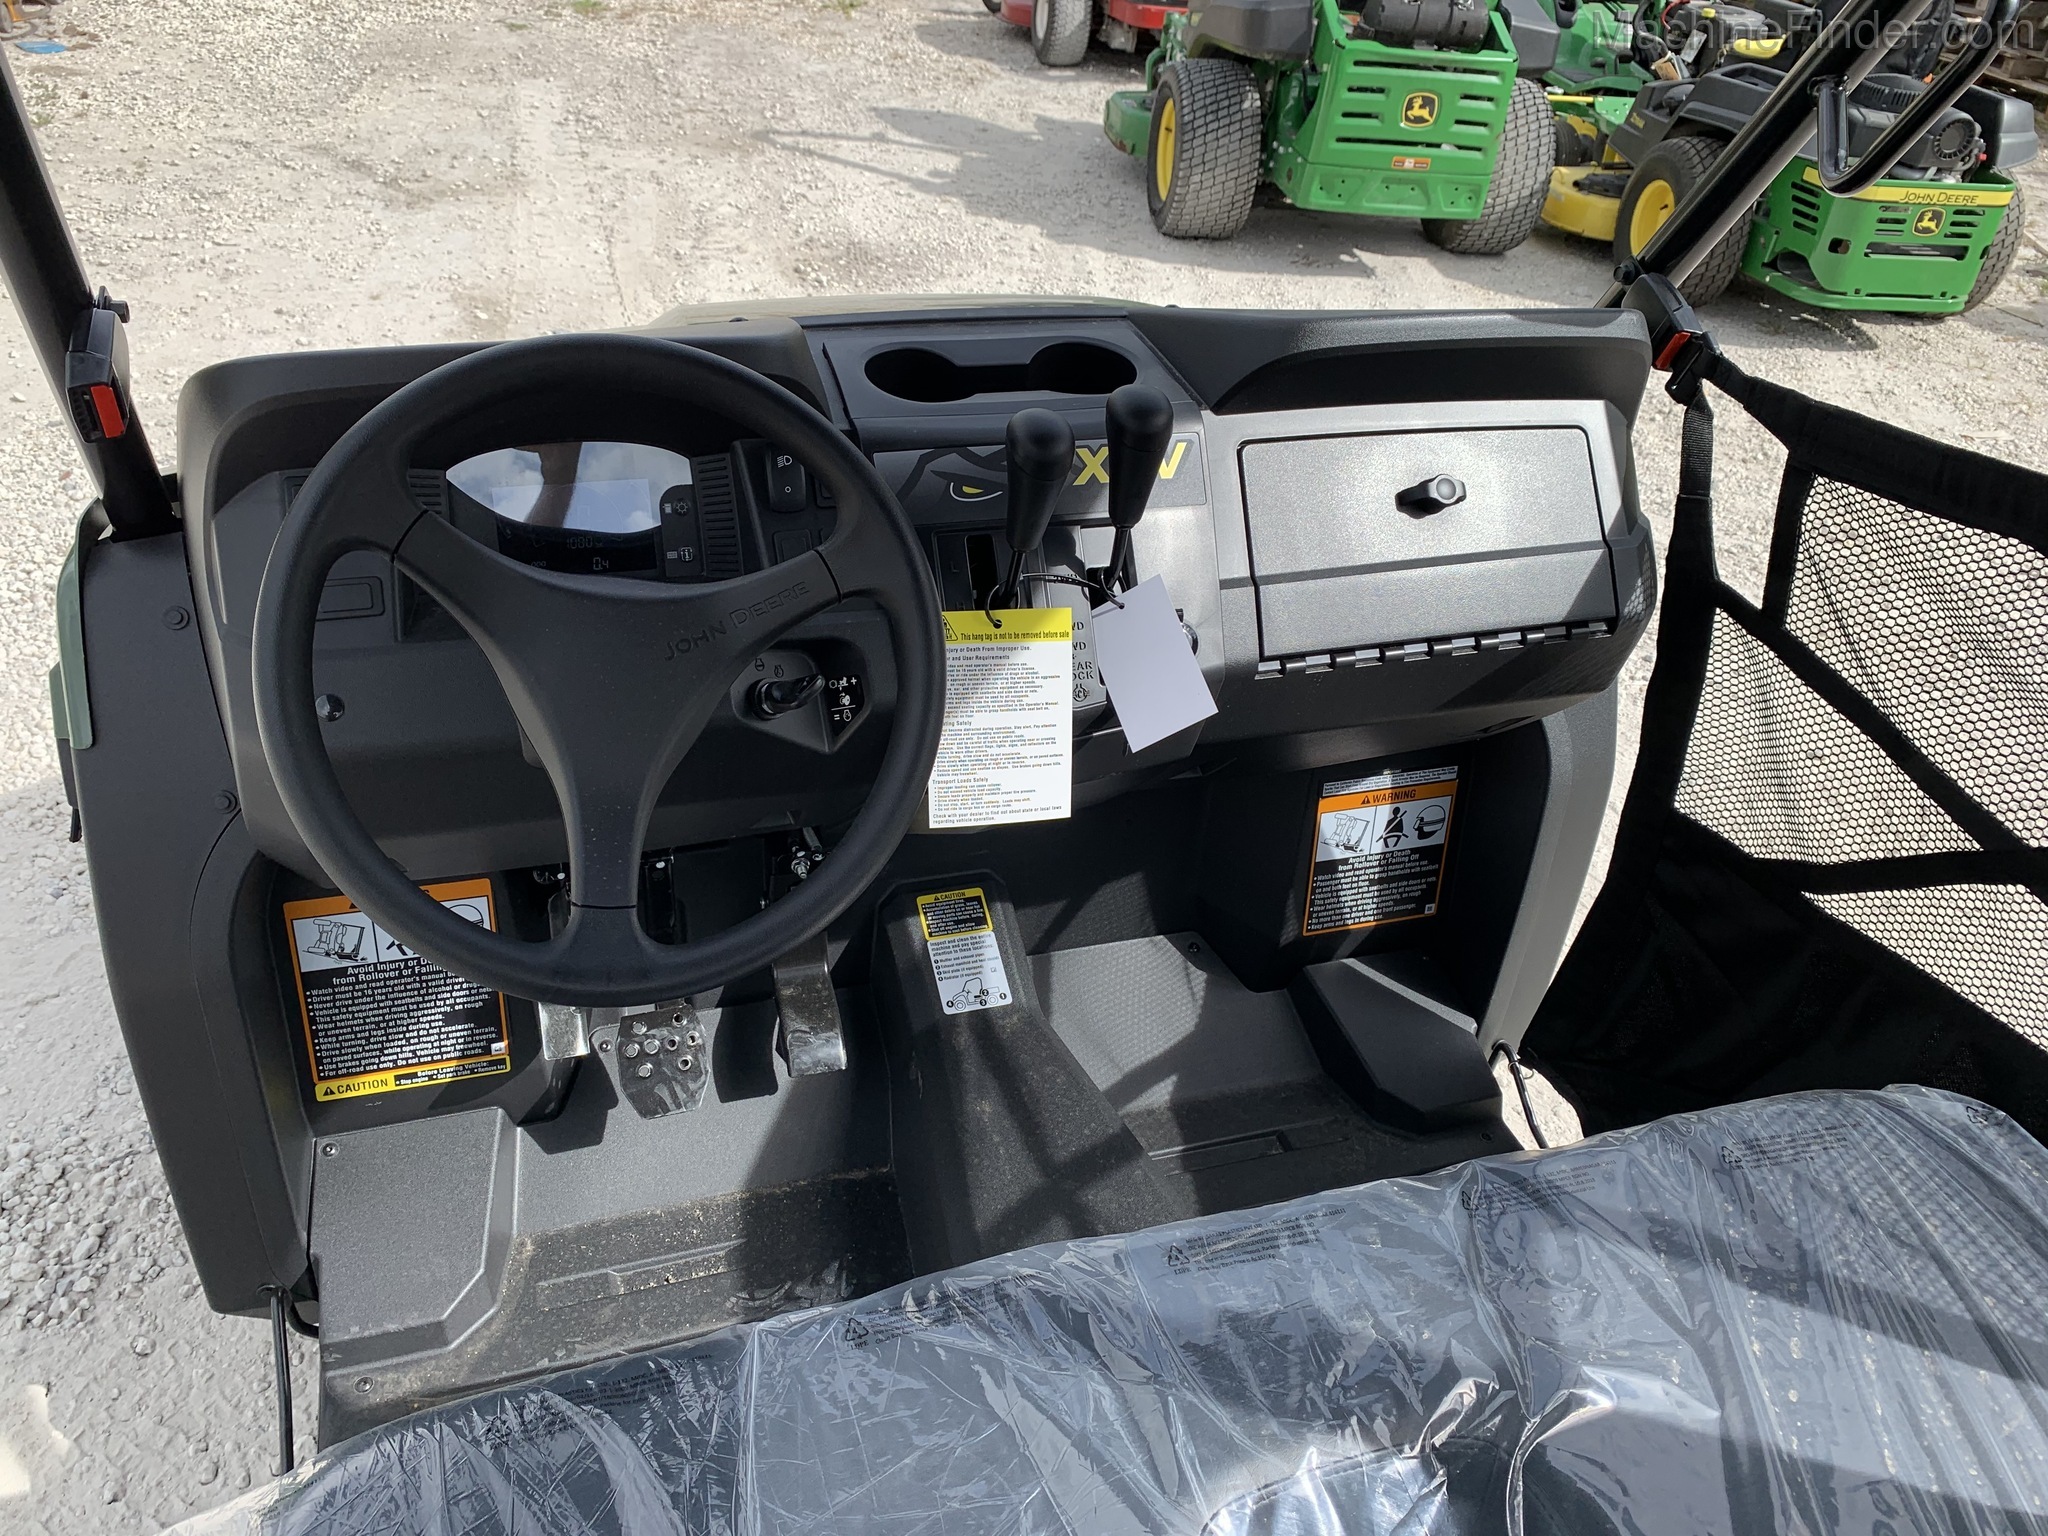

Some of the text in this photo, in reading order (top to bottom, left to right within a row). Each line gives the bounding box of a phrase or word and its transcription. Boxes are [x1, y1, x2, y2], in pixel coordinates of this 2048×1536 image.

[1900, 191, 1979, 204] JOHN DEERE
[1072, 441, 1189, 486] XV
[664, 581, 810, 662] JOHN DEERE
[972, 633, 984, 642] hang
[1021, 630, 1041, 638] removed
[1043, 629, 1058, 637] before
[996, 645, 1019, 653] Improper
[975, 654, 1010, 662] Requirements
[933, 778, 956, 786] Transport
[1373, 789, 1416, 802] WARNING
[1354, 860, 1380, 869] Rollover
[1388, 855, 1409, 865] Falling
[1366, 853, 1384, 862] Injury
[1393, 849, 1411, 857] Death
[940, 891, 966, 899] CAUTION
[333, 975, 357, 985] from
[358, 969, 401, 981] Rollover
[415, 963, 447, 974] Fallin
[347, 964, 376, 975] Avoid
[377, 960, 406, 972] Injury
[311, 987, 333, 995] Watch
[334, 984, 353, 992] video
[385, 975, 420, 986] operator's
[421, 972, 446, 980] manual
[312, 994, 334, 1002] Driver
[334, 991, 352, 999] must
[373, 987, 393, 995] years
[313, 1001, 334, 1009] Never
[335, 998, 353, 1006] drive
[354, 995, 374, 1004] under
[428, 984, 452, 993] alcohol
[315, 1007, 339, 1016] Vehicle
[348, 1002, 378, 1013] equipped
[394, 995, 423, 1005] seatbelts
[437, 991, 451, 999] side
[452, 989, 470, 997] doors
[319, 1035, 337, 1045] Keep
[370, 1028, 386, 1037] legs
[386, 1025, 407, 1033] inside
[408, 1022, 430, 1031] during
[320, 1042, 341, 1050] While
[341, 1038, 369, 1048] turning,
[369, 1035, 387, 1043] drive
[388, 1032, 404, 1040] slow
[441, 1022, 477, 1032] accelerate.
[337, 1065, 364, 1074] off-road
[379, 1060, 396, 1069] only.
[442, 1050, 463, 1060] public
[464, 1047, 484, 1055] roads.
[337, 1078, 388, 1095] CAUTION
